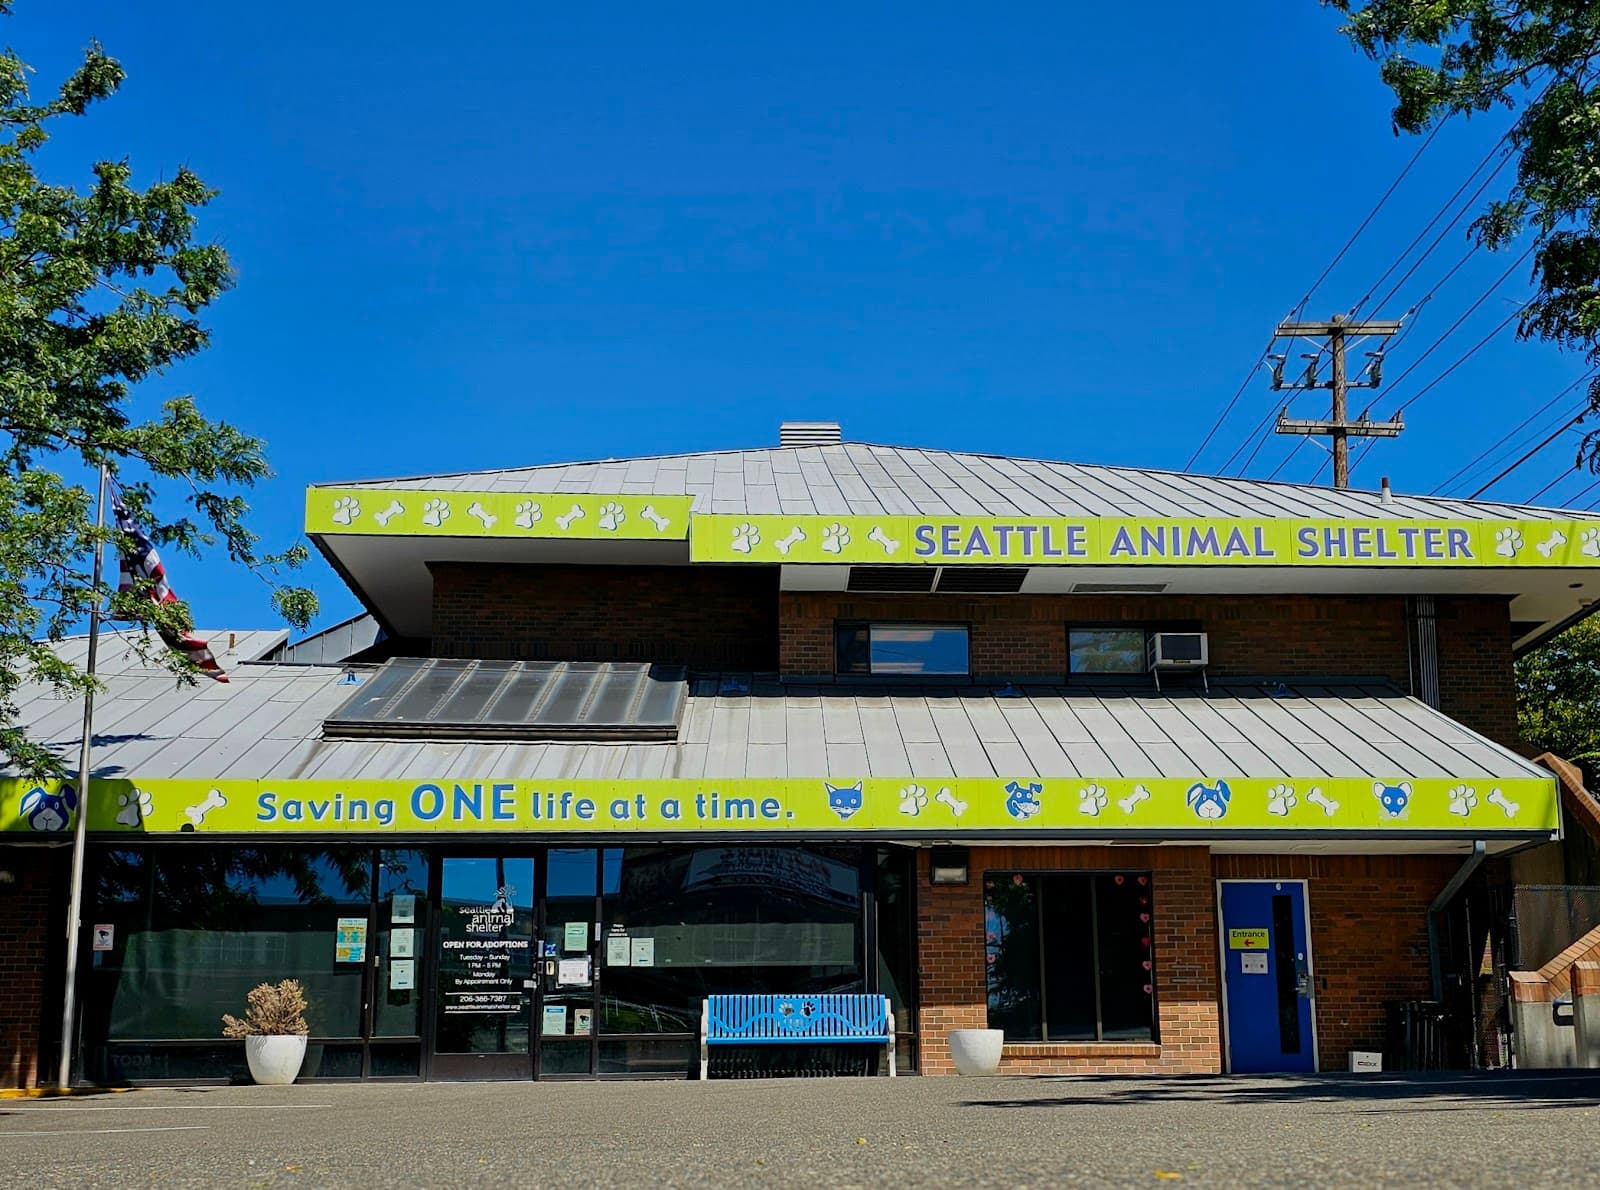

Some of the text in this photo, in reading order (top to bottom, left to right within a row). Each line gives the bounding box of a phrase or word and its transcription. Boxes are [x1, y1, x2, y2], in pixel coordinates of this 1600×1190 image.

[914, 525, 1475, 559] SEATTLE ANIMAL SHELTER
[256, 783, 795, 826] Saving ONE life at a time.
[458, 905, 491, 914] seattle
[471, 911, 515, 926] animal
[465, 922, 504, 933] shelter
[1232, 930, 1266, 938] Entrance
[442, 940, 529, 949] OPEN FOR ADOPTIONS
[489, 953, 511, 961] Sunday
[472, 971, 496, 979] Monday
[454, 978, 513, 986] By Appointment Only
